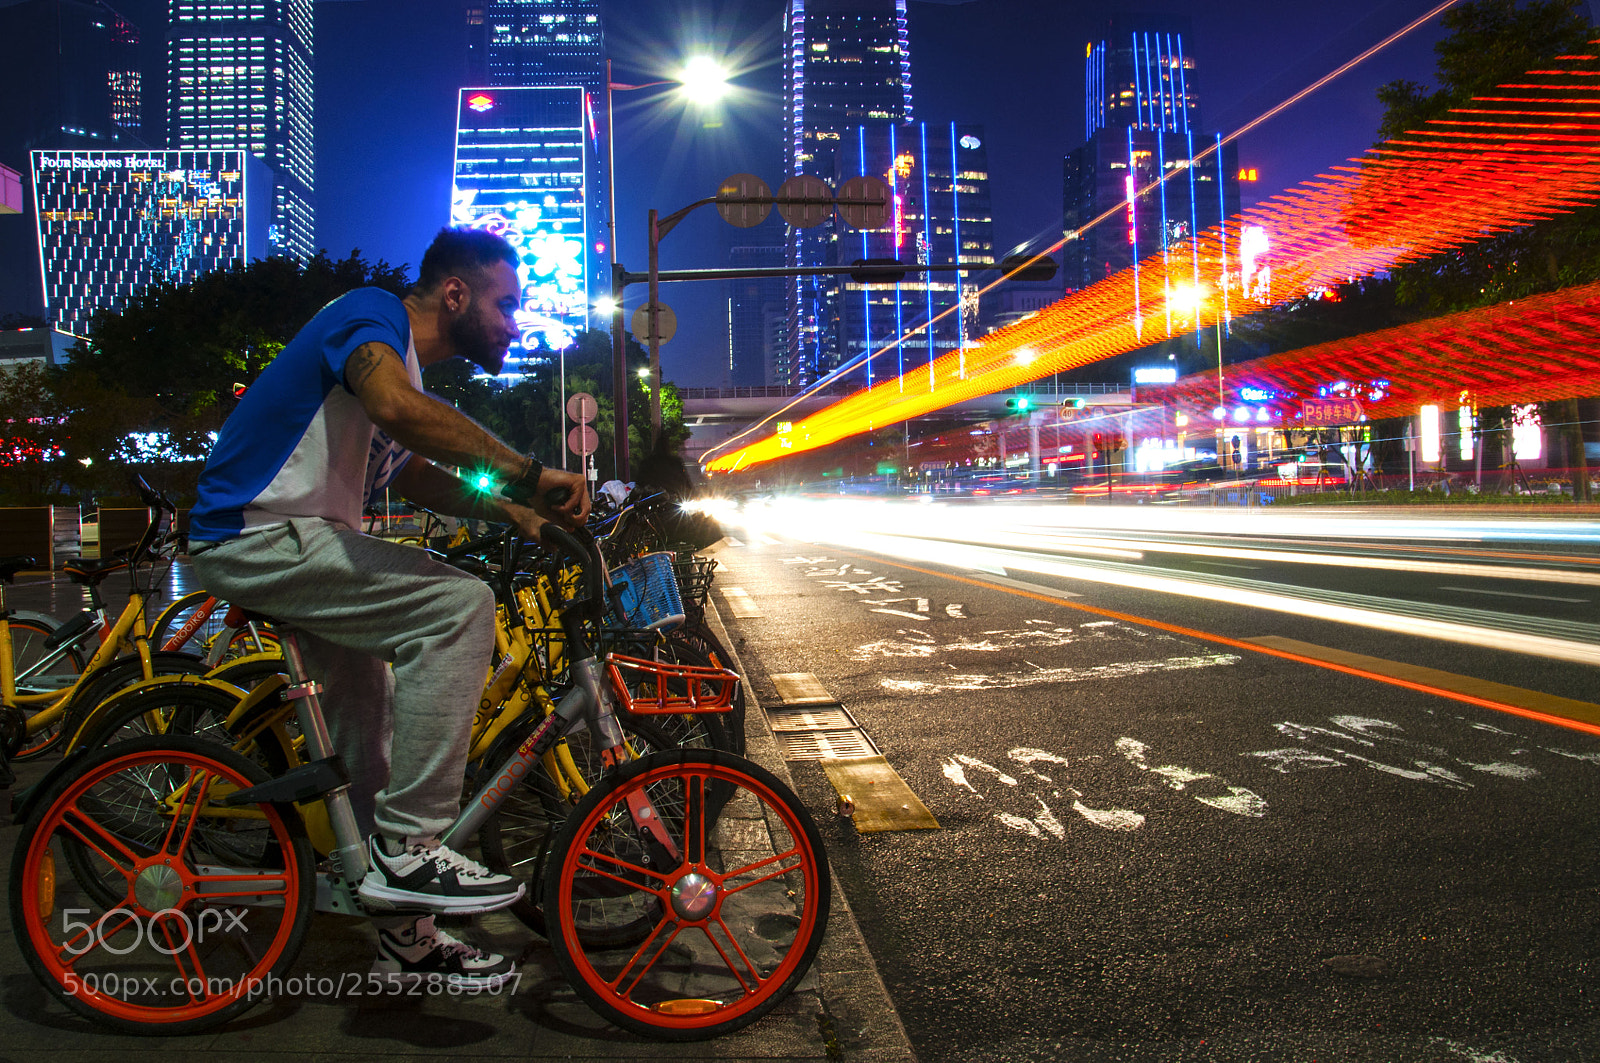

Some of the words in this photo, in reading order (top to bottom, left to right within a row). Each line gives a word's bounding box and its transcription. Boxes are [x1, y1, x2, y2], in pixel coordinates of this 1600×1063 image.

[40, 156, 71, 168] FOUR
[74, 156, 122, 168] SEASONS
[124, 155, 165, 168] HOTEL
[172, 610, 205, 647] mobike
